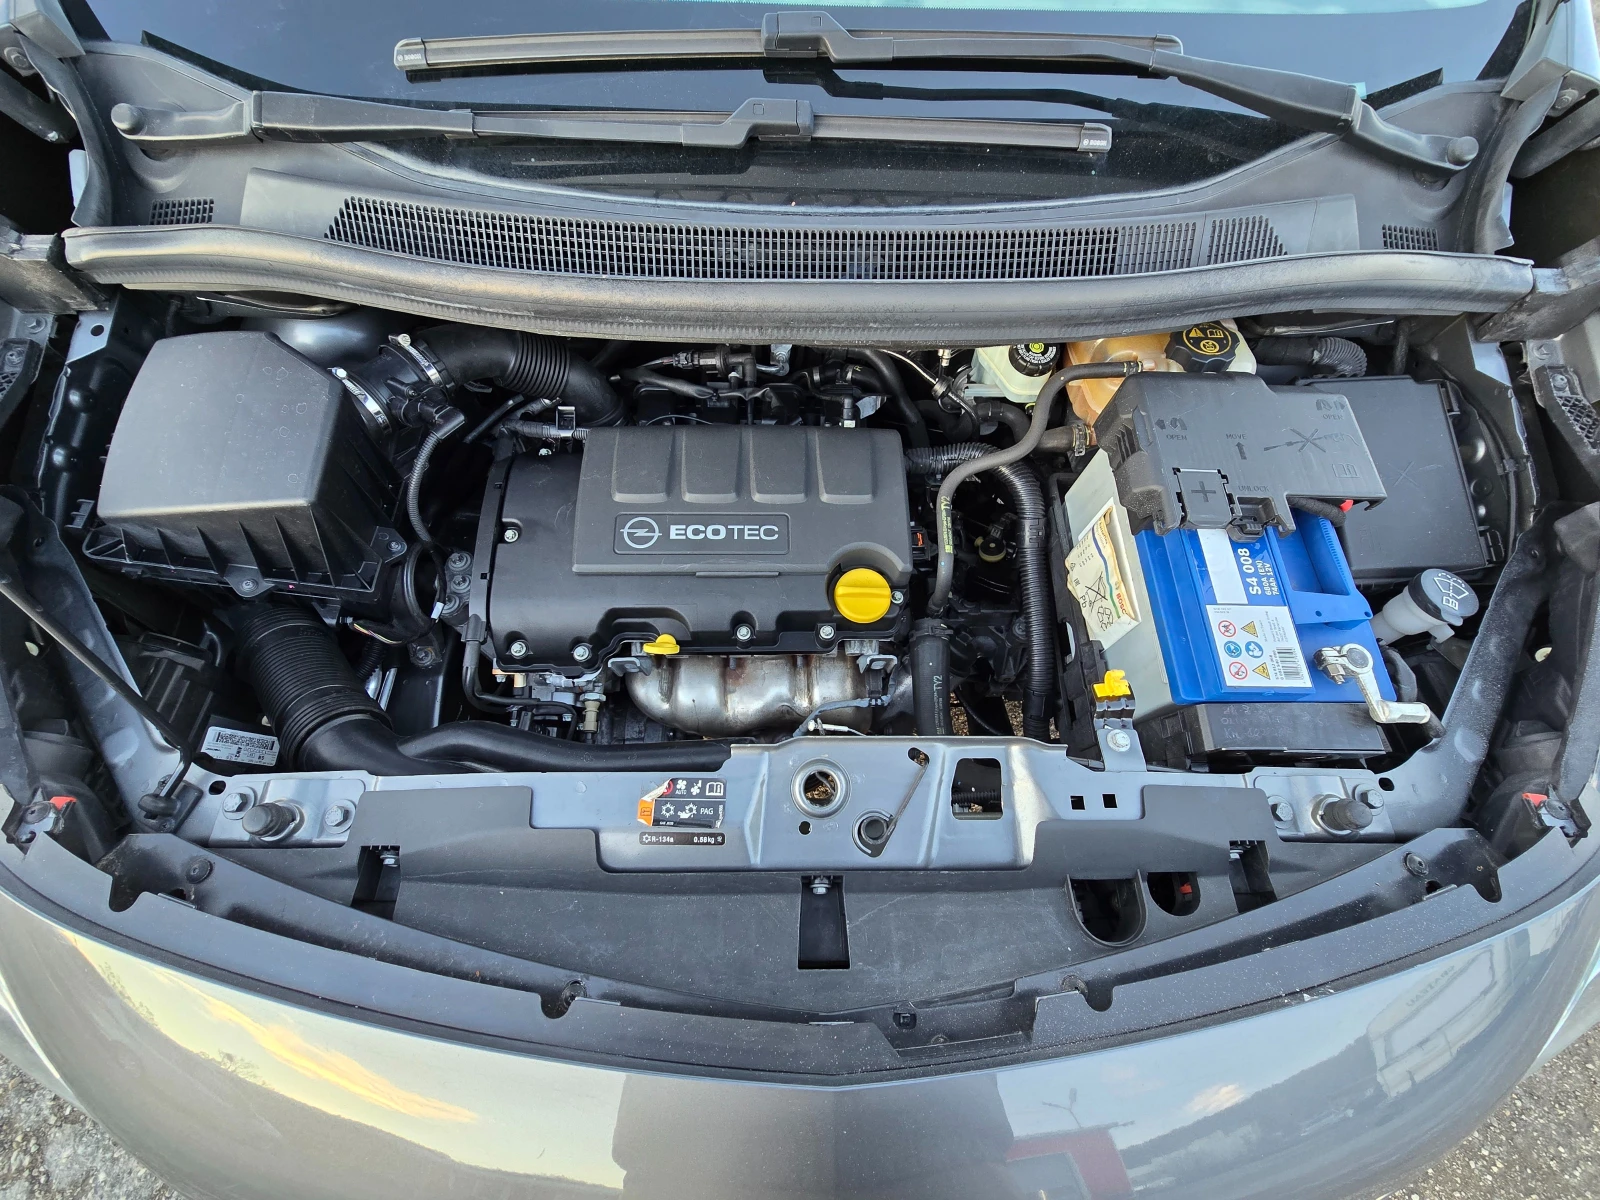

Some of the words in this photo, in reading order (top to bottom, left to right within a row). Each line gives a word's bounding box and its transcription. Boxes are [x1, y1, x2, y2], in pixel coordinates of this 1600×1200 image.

[1165, 433, 1188, 441] OPEN
[940, 495, 951, 511] TY2
[669, 524, 779, 540] ECOTEC
[1238, 548, 1255, 574] 008
[1257, 560, 1266, 575] (EN)
[1264, 563, 1275, 576] 12V
[1246, 576, 1262, 595] S4
[1261, 576, 1272, 596] 680A
[1269, 577, 1280, 596] 74Ah
[1079, 595, 1088, 608] Pb
[933, 675, 943, 691] TY2
[700, 807, 714, 815] PAG
